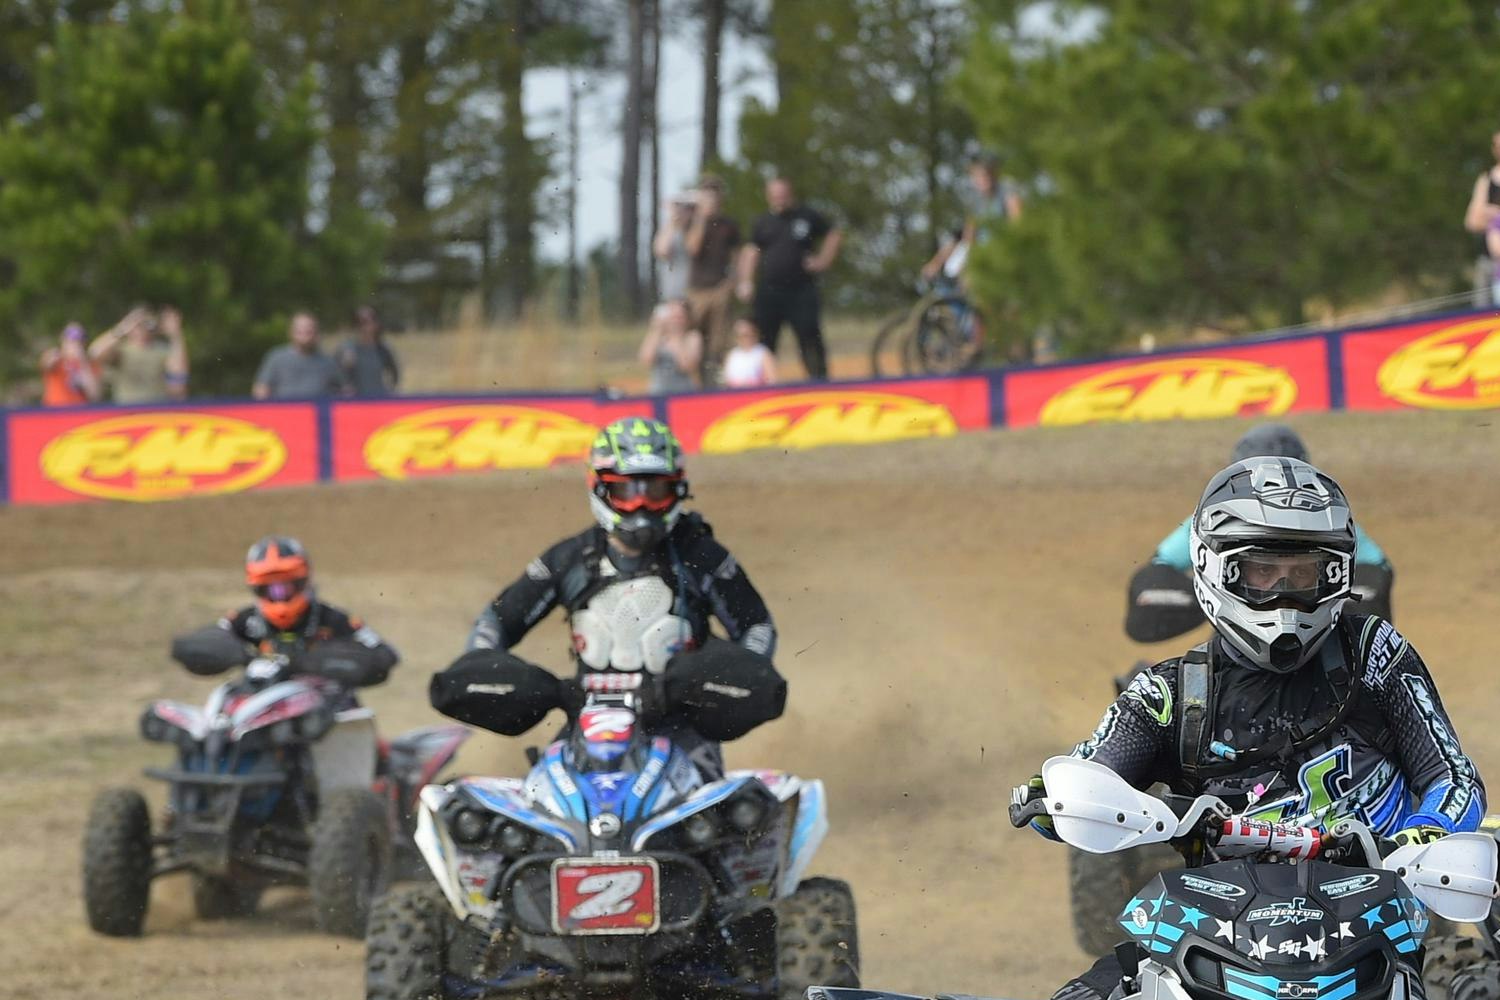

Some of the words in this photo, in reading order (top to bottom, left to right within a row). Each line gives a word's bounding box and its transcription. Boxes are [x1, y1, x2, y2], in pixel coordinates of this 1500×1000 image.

[1041, 362, 1293, 424] FMF
[42, 421, 282, 479] FMF
[583, 709, 635, 738] 2
[569, 870, 644, 919] 2
[1250, 910, 1322, 919] MOMENTUM
